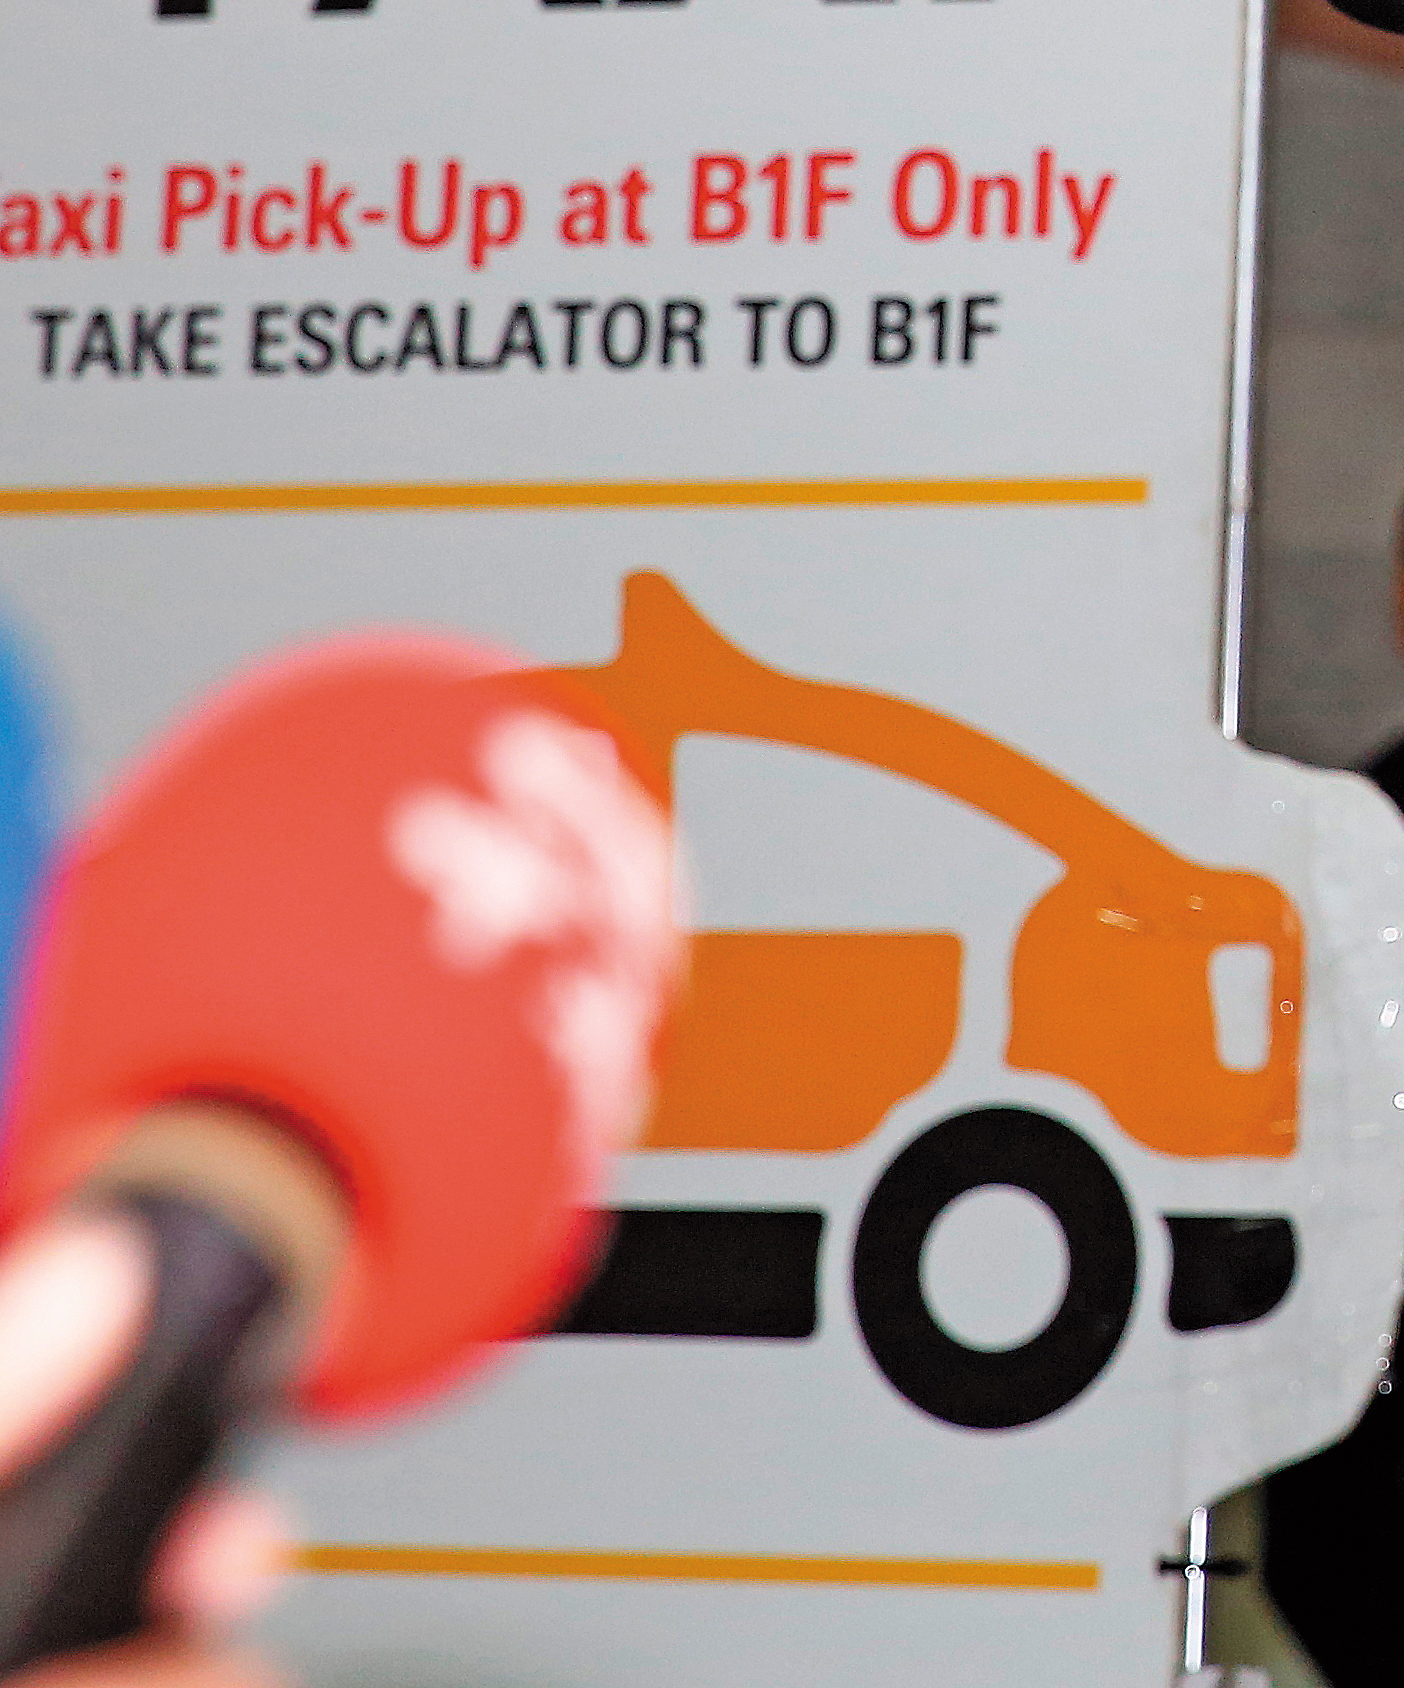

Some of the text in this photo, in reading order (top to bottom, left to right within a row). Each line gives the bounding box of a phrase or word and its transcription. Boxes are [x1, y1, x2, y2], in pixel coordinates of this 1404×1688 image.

[160, 157, 526, 273] Pick-Up
[559, 167, 653, 248] at
[689, 151, 857, 245] B1F
[891, 146, 1116, 262] Only
[31, 293, 1001, 380] TAKE ESCALATOR TO B1F
